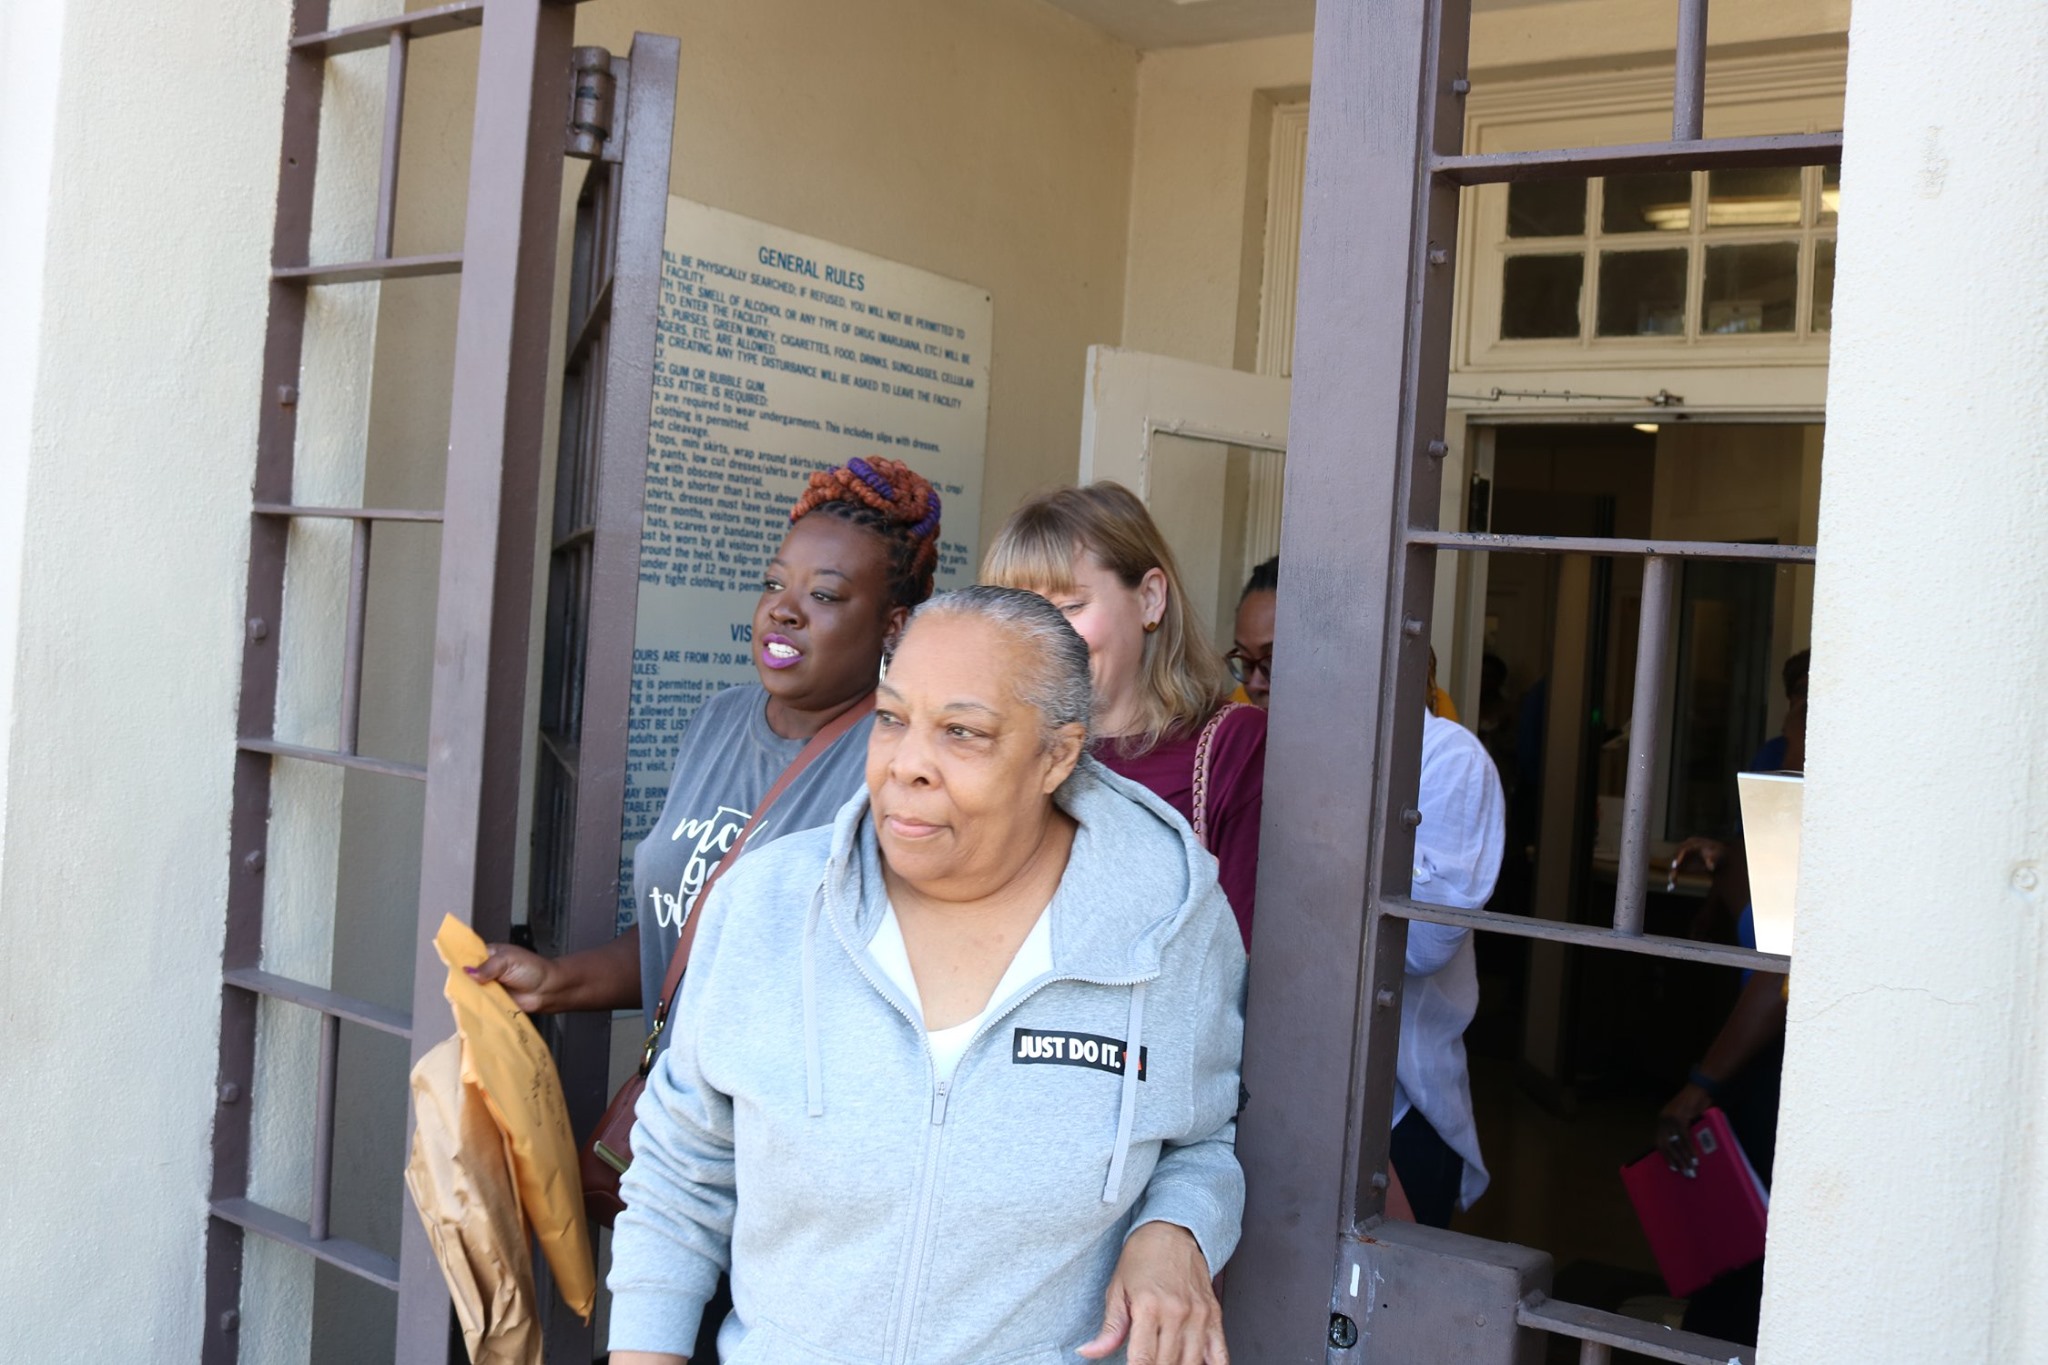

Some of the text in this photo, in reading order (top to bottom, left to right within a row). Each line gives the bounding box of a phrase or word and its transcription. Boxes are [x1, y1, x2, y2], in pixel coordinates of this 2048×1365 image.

[759, 246, 865, 291] GENERAL RULES
[665, 292, 675, 304] TO
[680, 296, 708, 312] ENTER
[713, 304, 728, 316] THE
[681, 254, 693, 266] BE
[697, 259, 748, 281] PHYSICALLY
[800, 287, 807, 297] IF
[850, 301, 865, 313] YOU
[868, 306, 884, 318] WILL
[887, 310, 901, 322] NOT
[904, 315, 914, 326] BE
[916, 318, 954, 337] PERMITTED
[956, 328, 965, 340] TO
[678, 282, 693, 295] THE
[698, 287, 725, 303] SMELL
[730, 294, 741, 306] OF
[744, 299, 781, 317] ALCOHOL
[786, 309, 796, 320] OR
[801, 313, 816, 324] ANY
[820, 317, 838, 331] TYPE
[842, 323, 851, 333] OF
[854, 326, 875, 341] DRUG
[944, 349, 959, 361] WILL
[962, 354, 970, 365] BE
[717, 333, 732, 345] ARE
[713, 319, 742, 334] GREEN
[941, 373, 974, 388] CELLULAR
[669, 337, 961, 408] CREATING ANY TYPE DISTURBANCE WILL BE ASKED TO LEAVE THE FACILITY
[669, 363, 689, 377] GUM
[693, 368, 706, 380] OR
[710, 371, 742, 389] BUBBLE
[678, 380, 708, 395] ATTIRE
[712, 386, 720, 397] IS
[655, 405, 691, 422] clothing
[696, 410, 702, 421] is
[664, 393, 678, 403] are
[683, 397, 719, 412] required
[723, 404, 732, 413] to
[736, 407, 756, 417] wear
[826, 421, 840, 434] This
[843, 426, 873, 441] includes
[877, 432, 892, 445] slips
[896, 436, 910, 447] with
[683, 437, 699, 449] mini
[735, 448, 754, 460] wrap
[758, 451, 786, 464] around
[665, 463, 683, 474] with
[687, 466, 724, 480] obscene
[693, 454, 707, 463] low
[712, 457, 725, 466] cut
[729, 460, 788, 477] dresses/shirts
[792, 471, 799, 479] or
[672, 477, 683, 488] be
[688, 478, 720, 492] shorter
[724, 485, 742, 495] than
[746, 486, 750, 498] 1
[754, 490, 771, 500] inch
[679, 492, 713, 506] dresses
[718, 498, 738, 509] must
[742, 502, 761, 512] have
[710, 511, 740, 524] visitors
[744, 517, 761, 527] may
[765, 519, 784, 528] wear
[673, 520, 707, 532] scarves
[712, 525, 720, 534] or
[724, 525, 763, 539] bandanas
[767, 532, 782, 541] can
[660, 532, 671, 542] be
[676, 535, 697, 544] worn
[701, 536, 711, 548] by
[716, 538, 725, 548] all
[729, 539, 758, 553] visitors
[763, 544, 771, 553] to
[675, 546, 689, 558] the
[718, 551, 730, 562] No
[734, 552, 762, 565] slip-on
[641, 558, 760, 578] under age of 12 may wear
[665, 573, 735, 591] tight clothing is
[663, 651, 731, 664] ARE FROM 7:00
[648, 678, 654, 689] is
[658, 680, 702, 690] permitted
[706, 680, 713, 690] in
[718, 681, 730, 690] the
[646, 692, 701, 704] is permitted
[639, 706, 674, 716] allowed
[678, 707, 687, 716] to
[655, 720, 667, 730] BE
[630, 734, 678, 744] adults and
[629, 746, 667, 758] must be
[1017, 1035, 1121, 1068] JUST DO IT.
